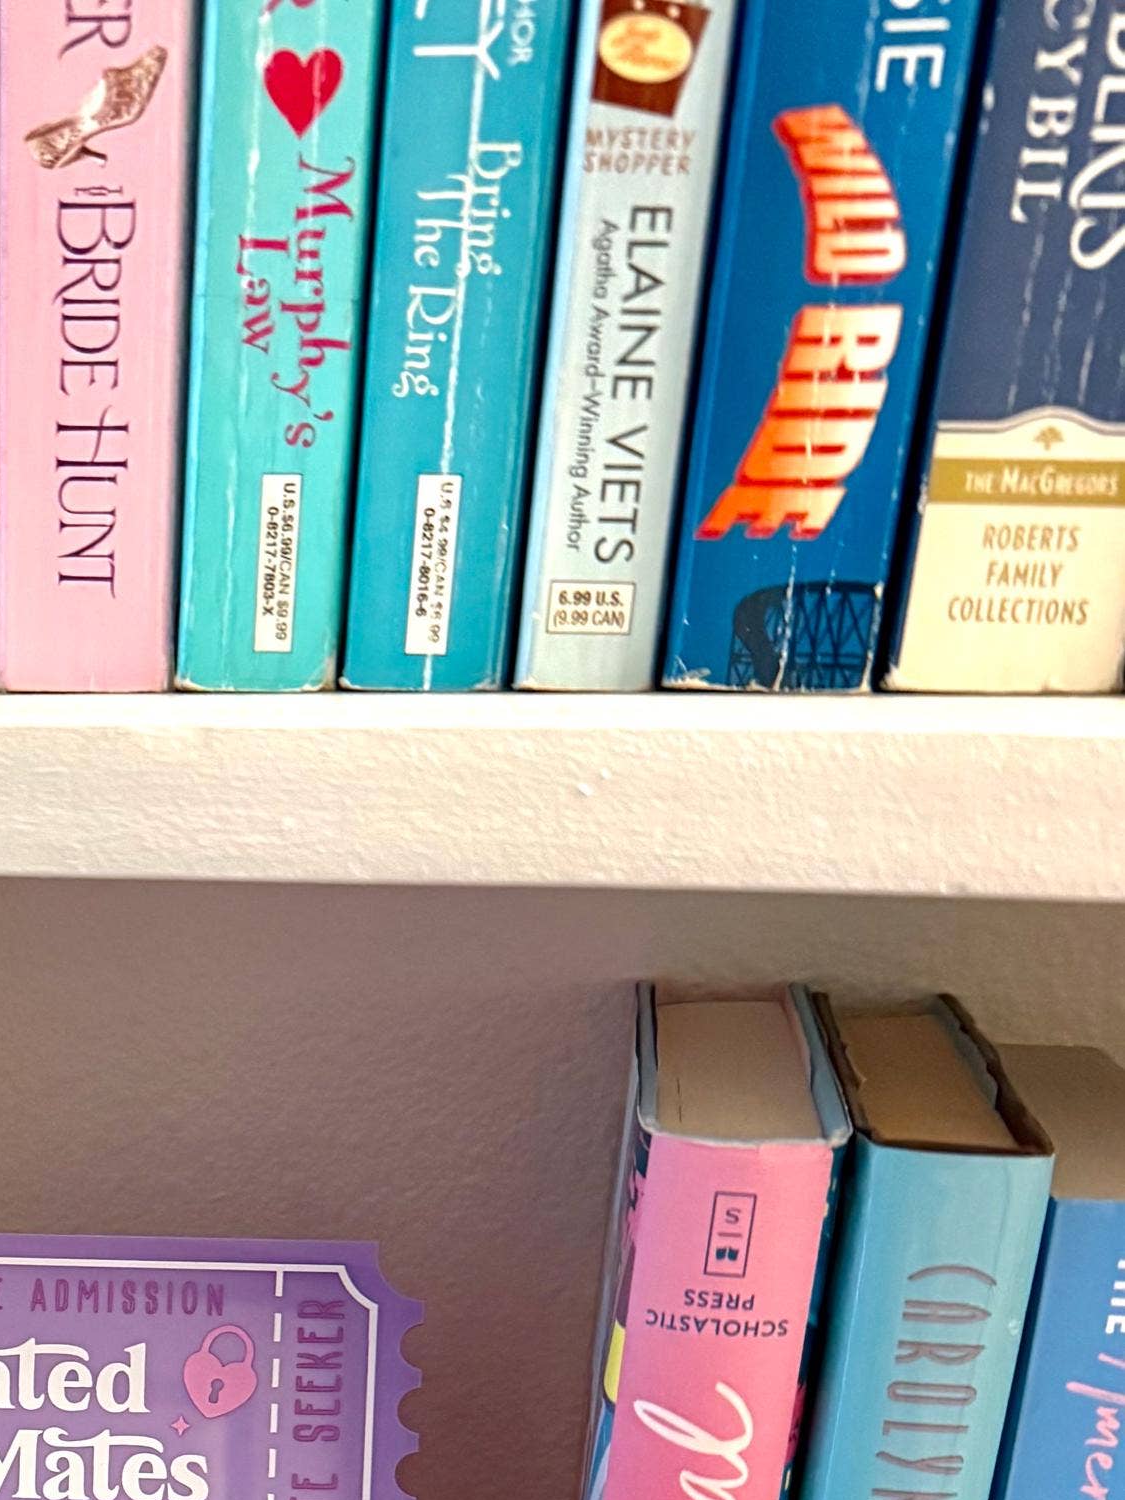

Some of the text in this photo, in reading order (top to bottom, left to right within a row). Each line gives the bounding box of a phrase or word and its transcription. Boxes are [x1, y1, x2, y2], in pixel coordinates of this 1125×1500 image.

[585, 126, 696, 152] MYSTERY
[582, 152, 690, 176] SHOPPER
[470, 141, 522, 276] Bring
[235, 234, 290, 355] Law
[270, 155, 354, 449] Murphy's
[392, 172, 472, 400] The Ring
[694, 104, 907, 540] WILD RIDE
[54, 200, 137, 599] BRIDE HUNT
[565, 219, 620, 551] Agatha Award-Winning Author
[594, 205, 674, 565] ELAINE VIETS
[981, 524, 1080, 551] ROBERTS
[987, 562, 1063, 588] FAMILY
[553, 608, 625, 628] (9.99 CAN)
[558, 592, 624, 607] 6.99 U.S.
[947, 597, 1088, 625] COLLECTIONS
[29, 1276, 227, 1318] ADMISSION
[683, 1288, 755, 1311] PRESS
[645, 1308, 790, 1337] SCHOLASTIC
[293, 1296, 346, 1444] SEEKER
